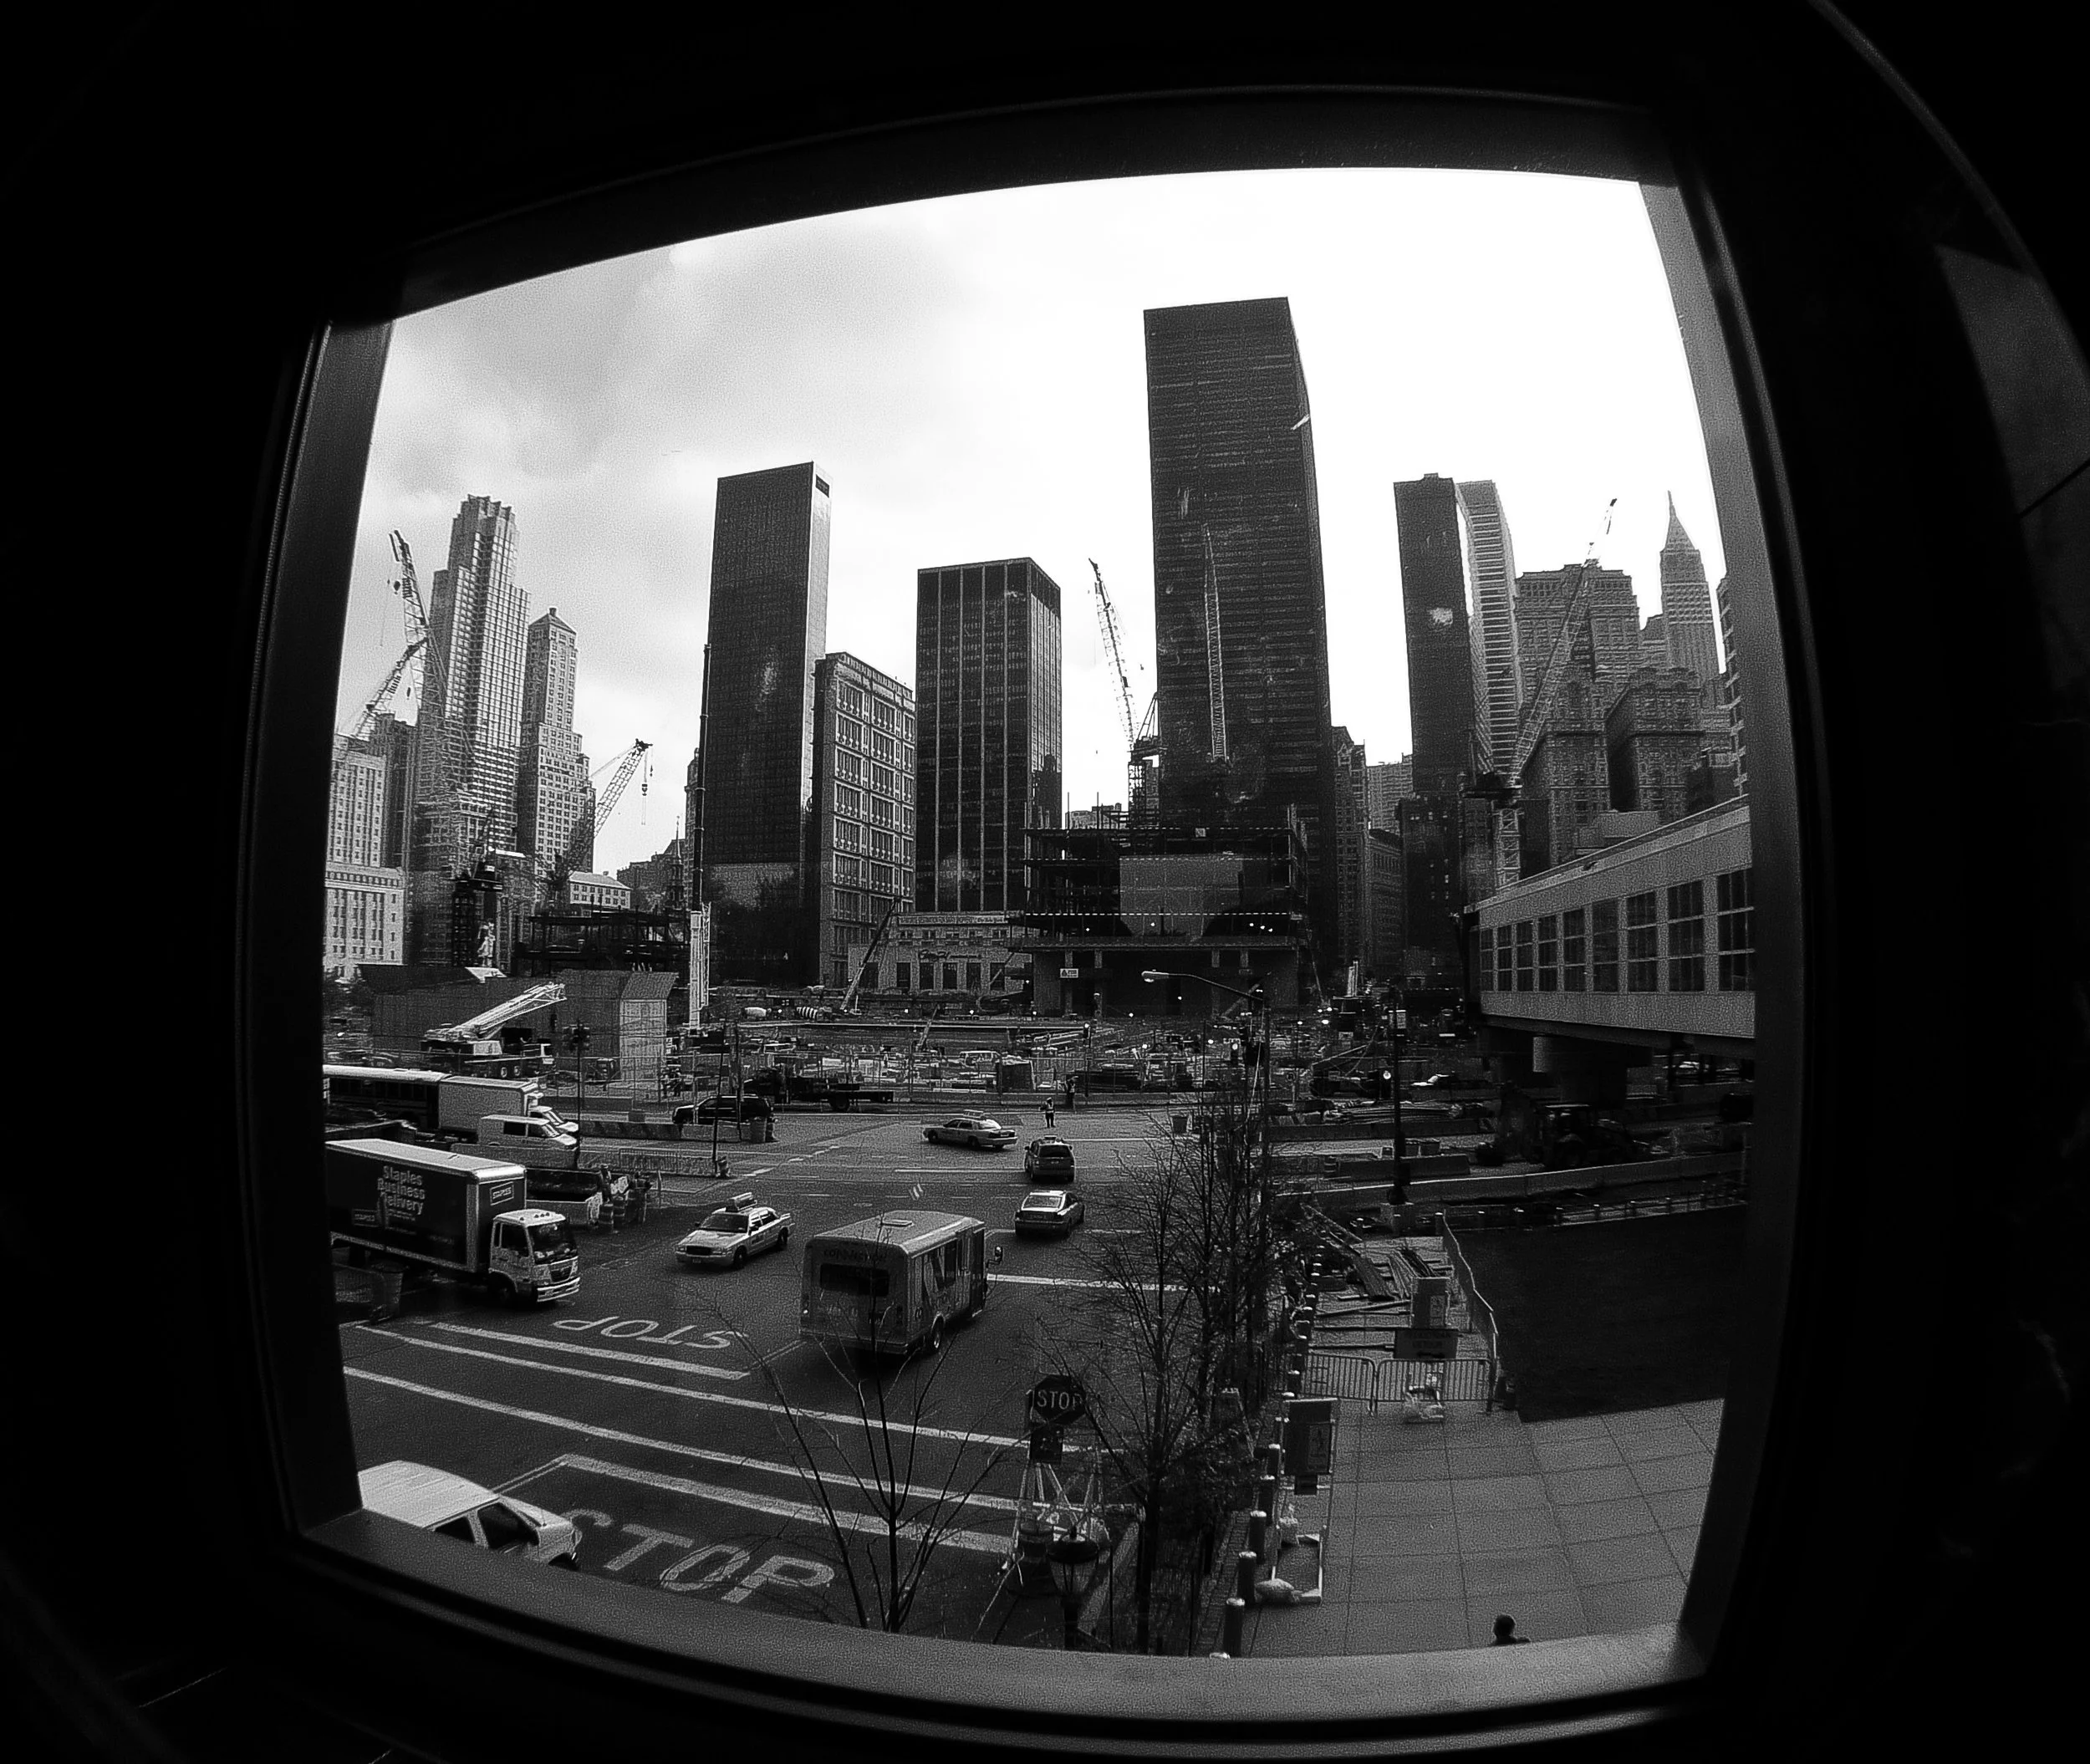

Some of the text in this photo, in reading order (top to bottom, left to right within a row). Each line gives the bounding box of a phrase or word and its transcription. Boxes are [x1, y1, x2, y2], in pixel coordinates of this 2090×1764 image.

[382, 1165, 423, 1185] Staples
[377, 1177, 426, 1200] Business
[552, 1316, 744, 1349] STOP
[1036, 1389, 1083, 1410] STOP
